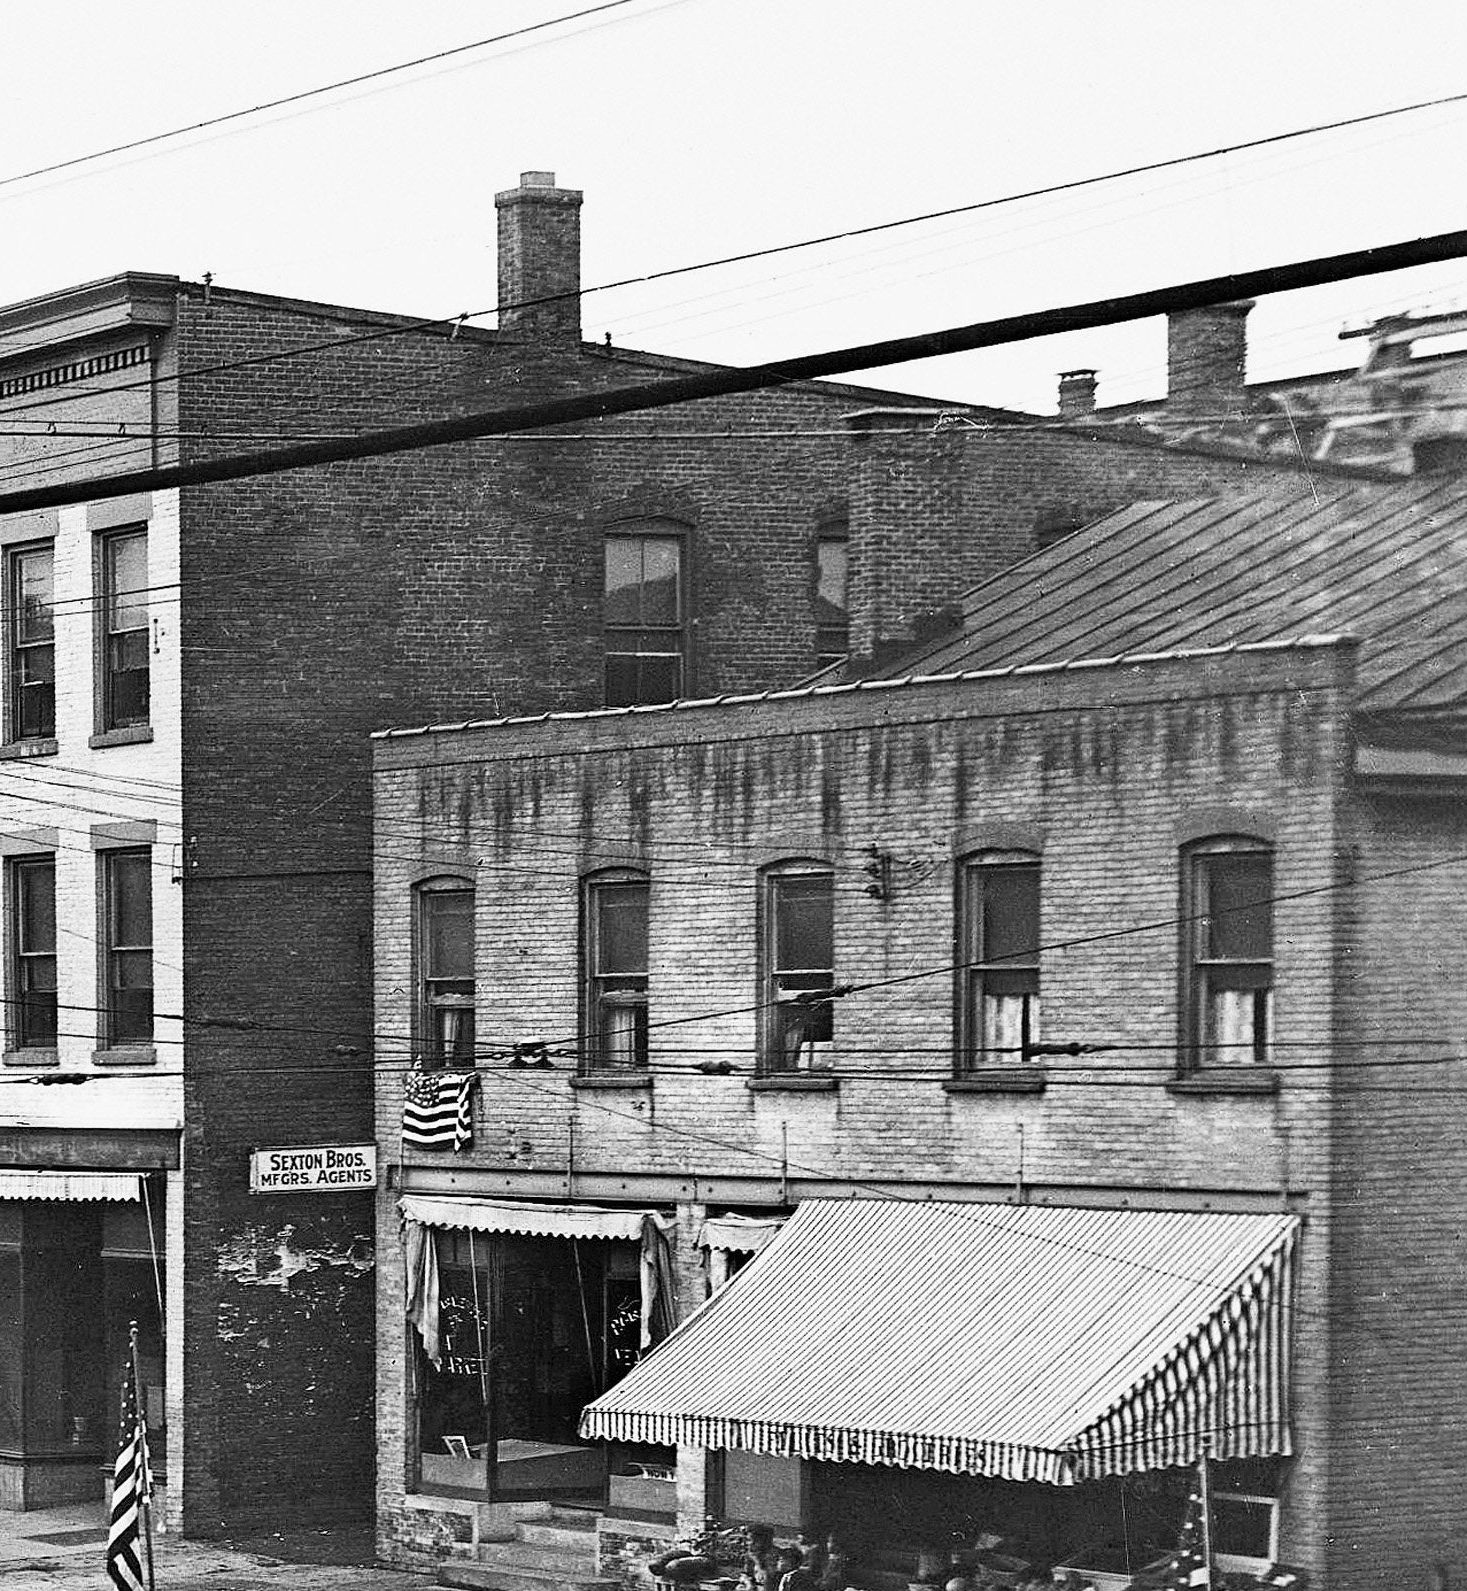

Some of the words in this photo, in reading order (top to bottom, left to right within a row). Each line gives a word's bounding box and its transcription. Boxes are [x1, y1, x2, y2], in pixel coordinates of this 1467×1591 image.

[270, 1154, 322, 1171] SEXTON
[326, 1150, 366, 1168] BROS.
[261, 1173, 312, 1186] MFGRS.
[316, 1169, 372, 1184] AGENTS
